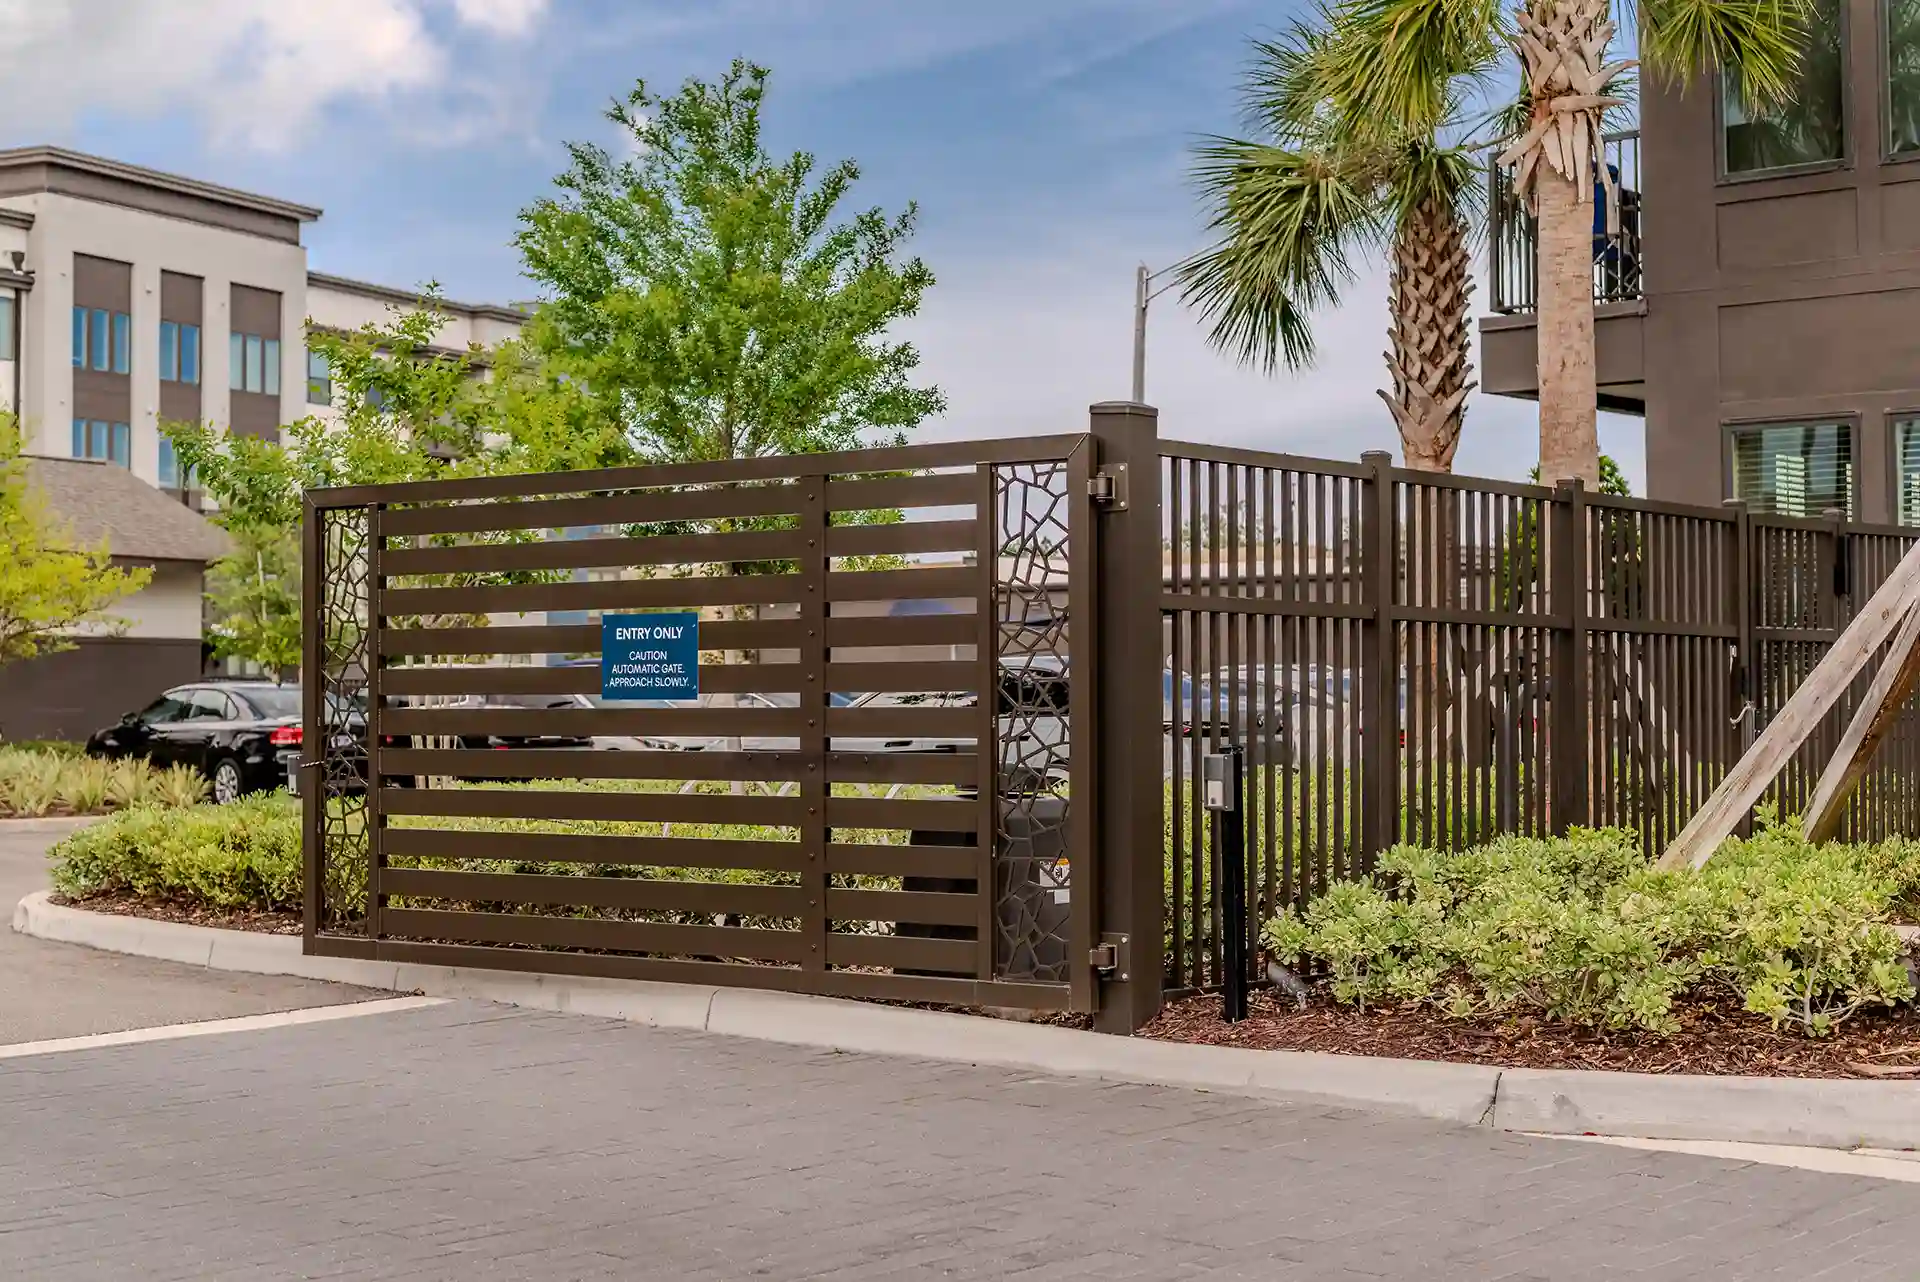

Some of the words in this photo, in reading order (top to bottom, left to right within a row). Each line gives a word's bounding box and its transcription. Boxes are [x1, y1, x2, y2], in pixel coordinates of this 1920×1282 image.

[616, 627, 651, 640] ENTRY
[653, 626, 683, 639] ONLY
[629, 650, 668, 661] CAUTION
[611, 664, 660, 674] AUTOMATIC
[661, 663, 685, 673] GATE.
[609, 677, 653, 687] APPROACH
[654, 676, 690, 687] SLOWLY.
